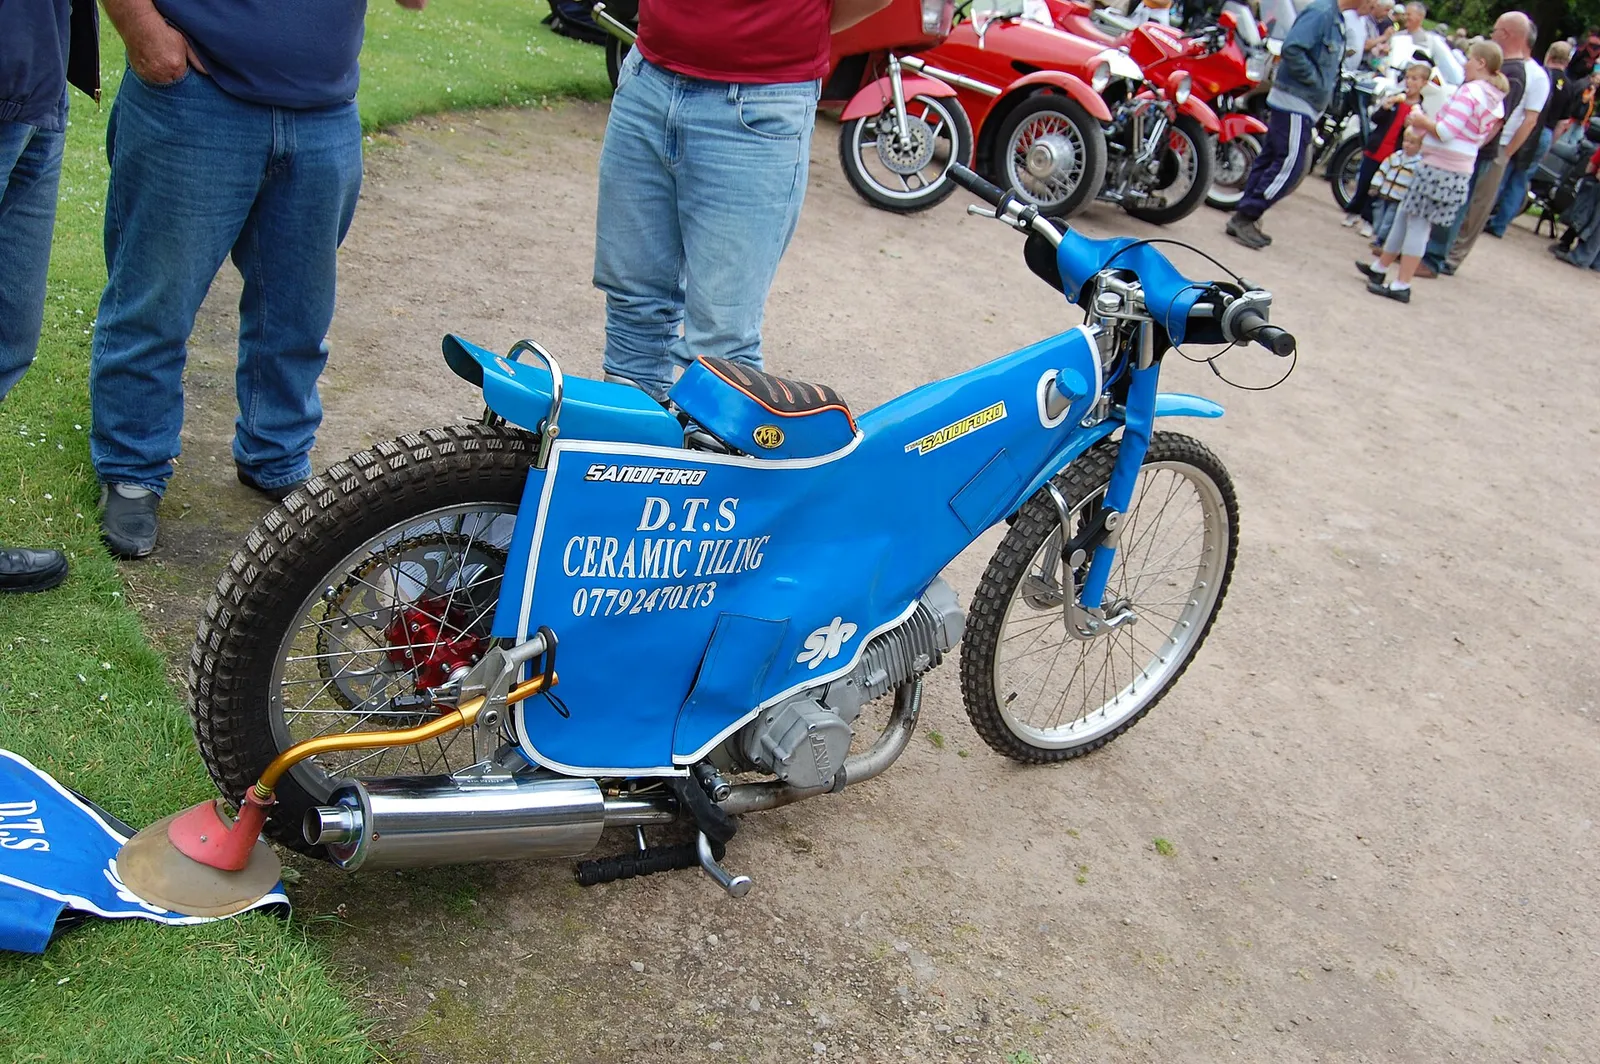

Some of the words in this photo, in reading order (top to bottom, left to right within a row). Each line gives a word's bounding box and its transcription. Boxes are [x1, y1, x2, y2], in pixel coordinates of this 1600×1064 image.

[920, 402, 1004, 453] SANDIFORD
[584, 463, 707, 486] SANDIFORD
[636, 496, 740, 532] D.T.S
[563, 535, 692, 579] CERAMIC
[694, 534, 771, 577] TILING
[572, 581, 718, 617] 07792470173
